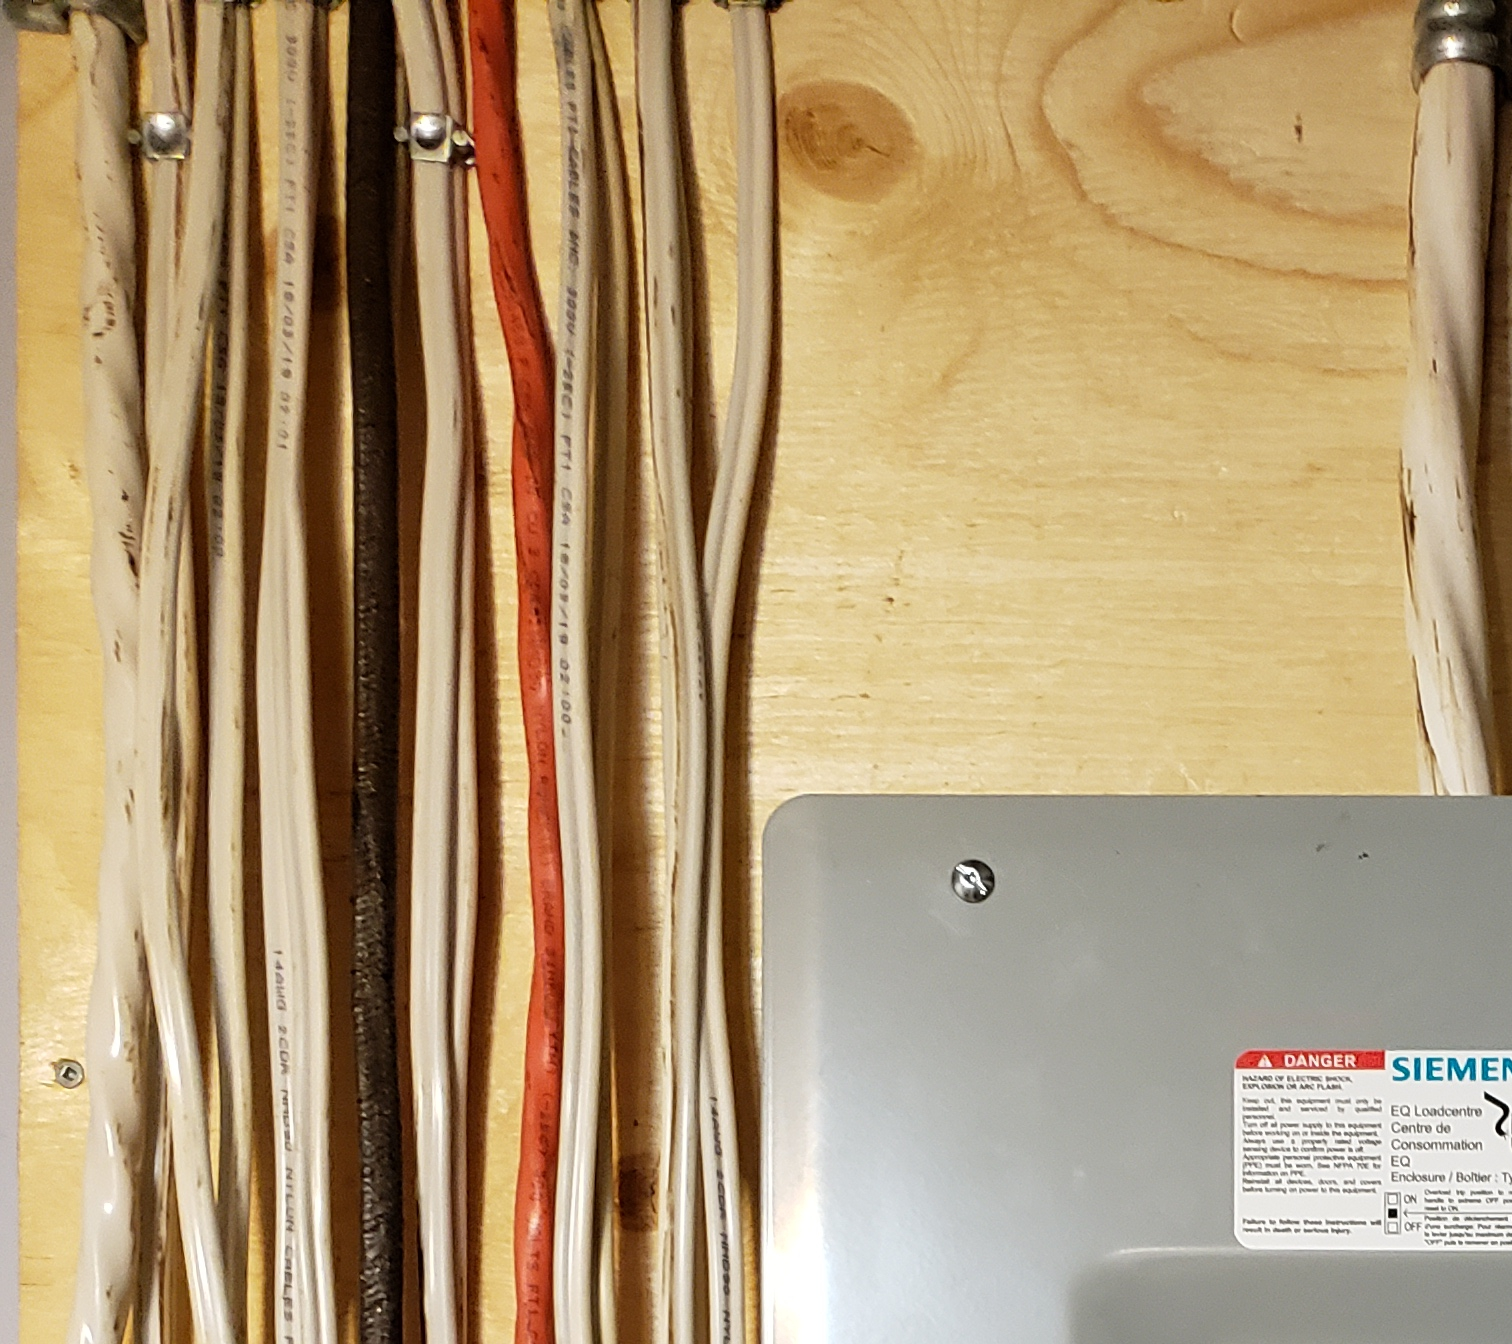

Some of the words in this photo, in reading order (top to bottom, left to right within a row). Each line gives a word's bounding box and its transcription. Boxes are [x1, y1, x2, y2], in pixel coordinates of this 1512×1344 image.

[1285, 1054, 1355, 1067] DANGER
[1391, 1105, 1410, 1117] EQ
[1415, 1105, 1482, 1117] Loadcentre
[1391, 1122, 1432, 1133] Centre
[1436, 1122, 1451, 1133] de
[1391, 1139, 1482, 1150] Consommation
[1391, 1156, 1410, 1167] EQ
[1391, 1172, 1445, 1182] Enclosure
[1404, 1195, 1417, 1204] ON
[1404, 1222, 1422, 1231] OFF
